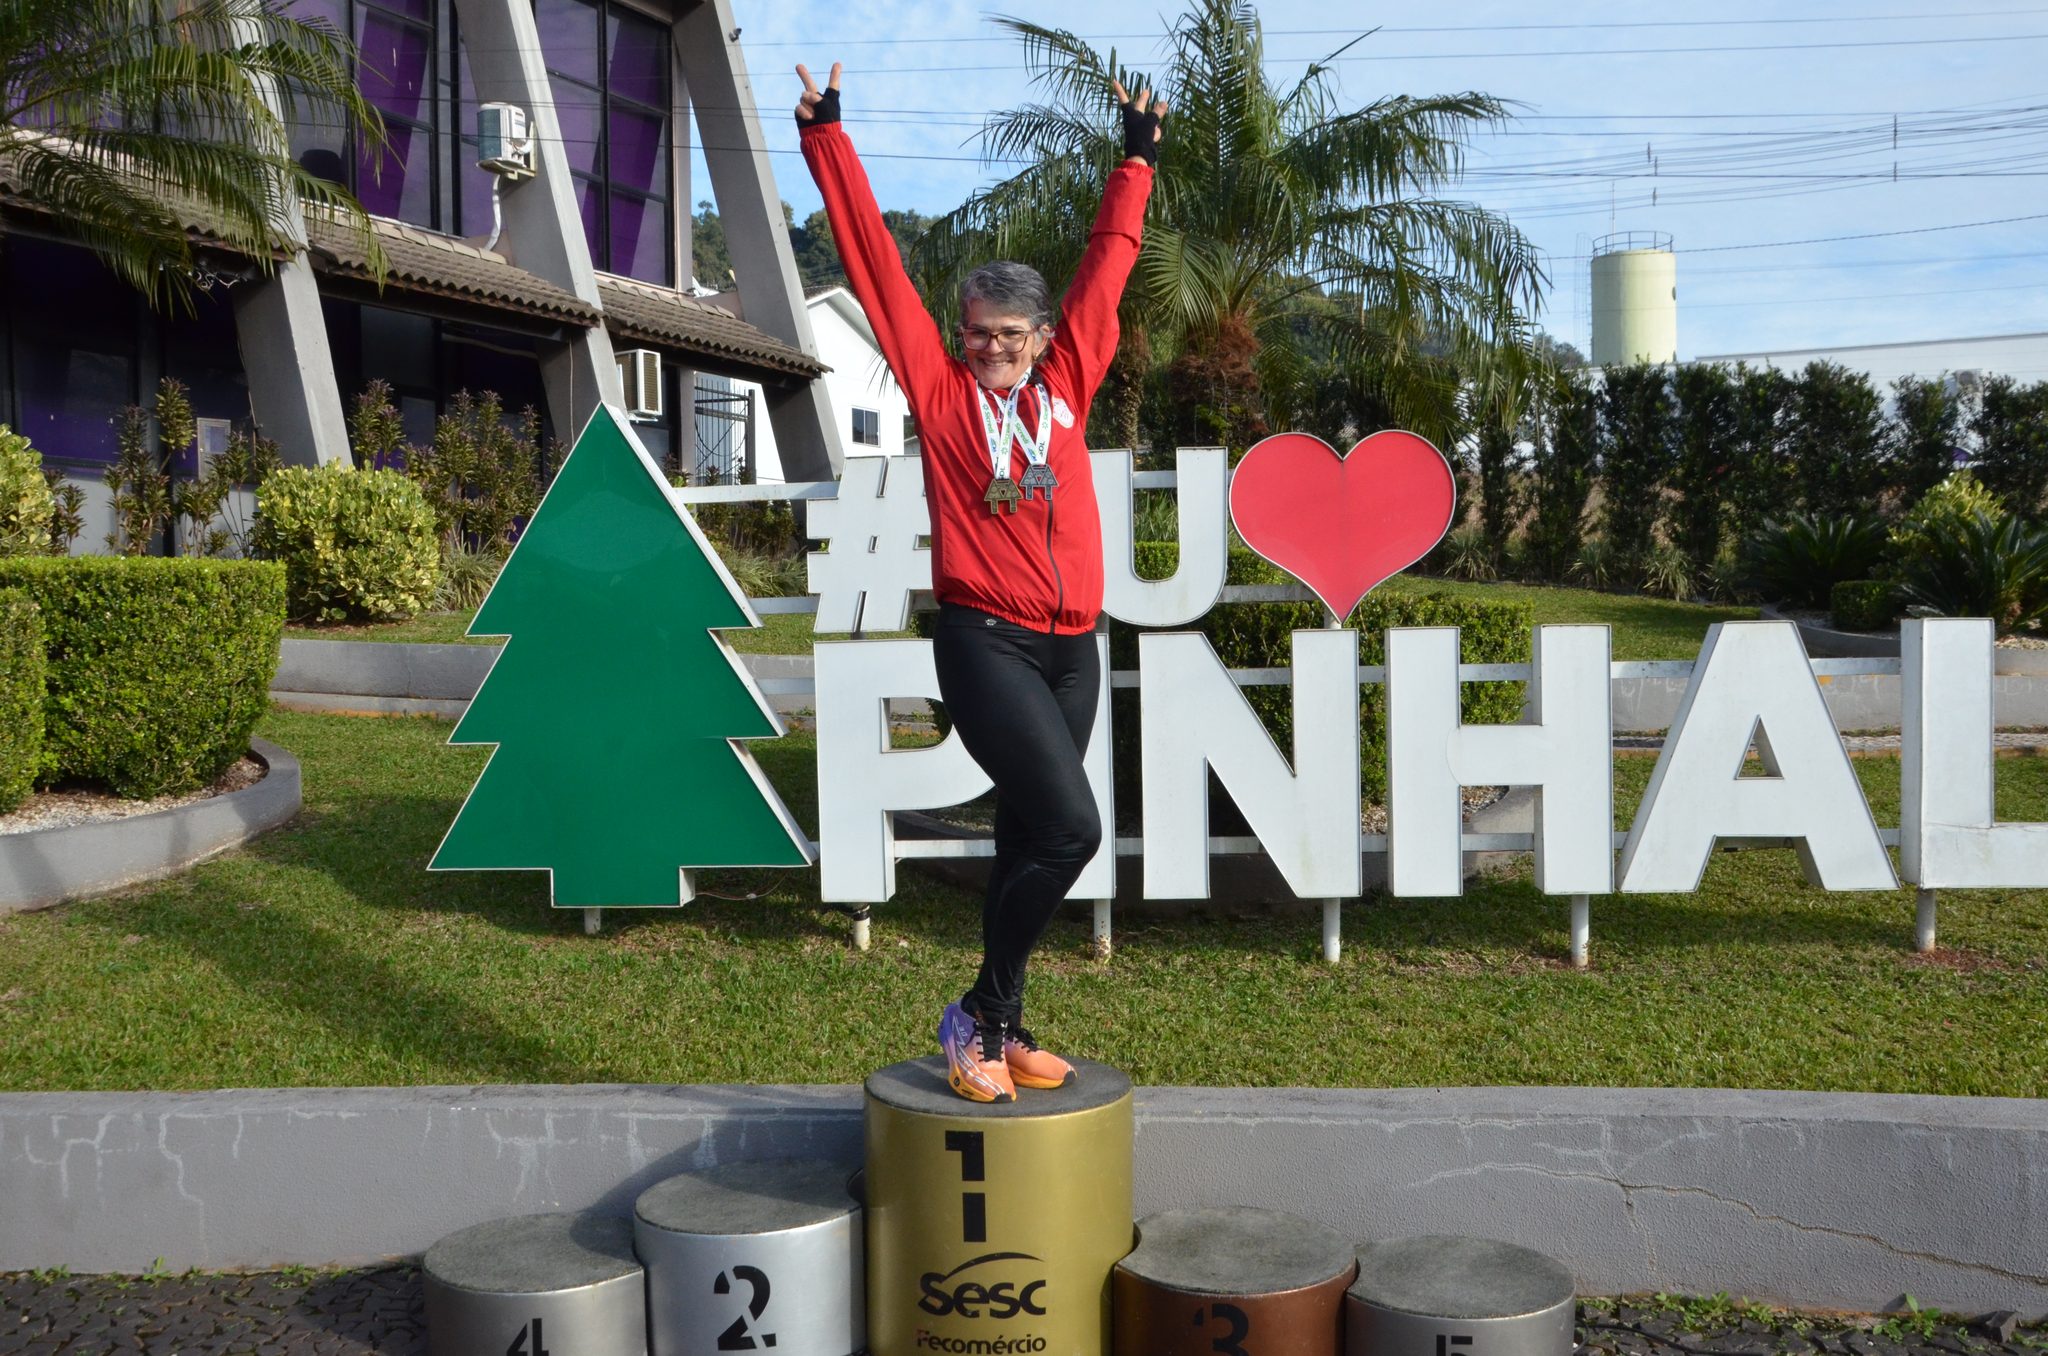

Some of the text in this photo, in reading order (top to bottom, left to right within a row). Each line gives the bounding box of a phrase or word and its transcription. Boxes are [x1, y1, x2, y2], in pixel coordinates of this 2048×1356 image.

[945, 1130, 987, 1243] 1
[713, 1265, 777, 1351] 2
[918, 1252, 1047, 1319] Sesc
